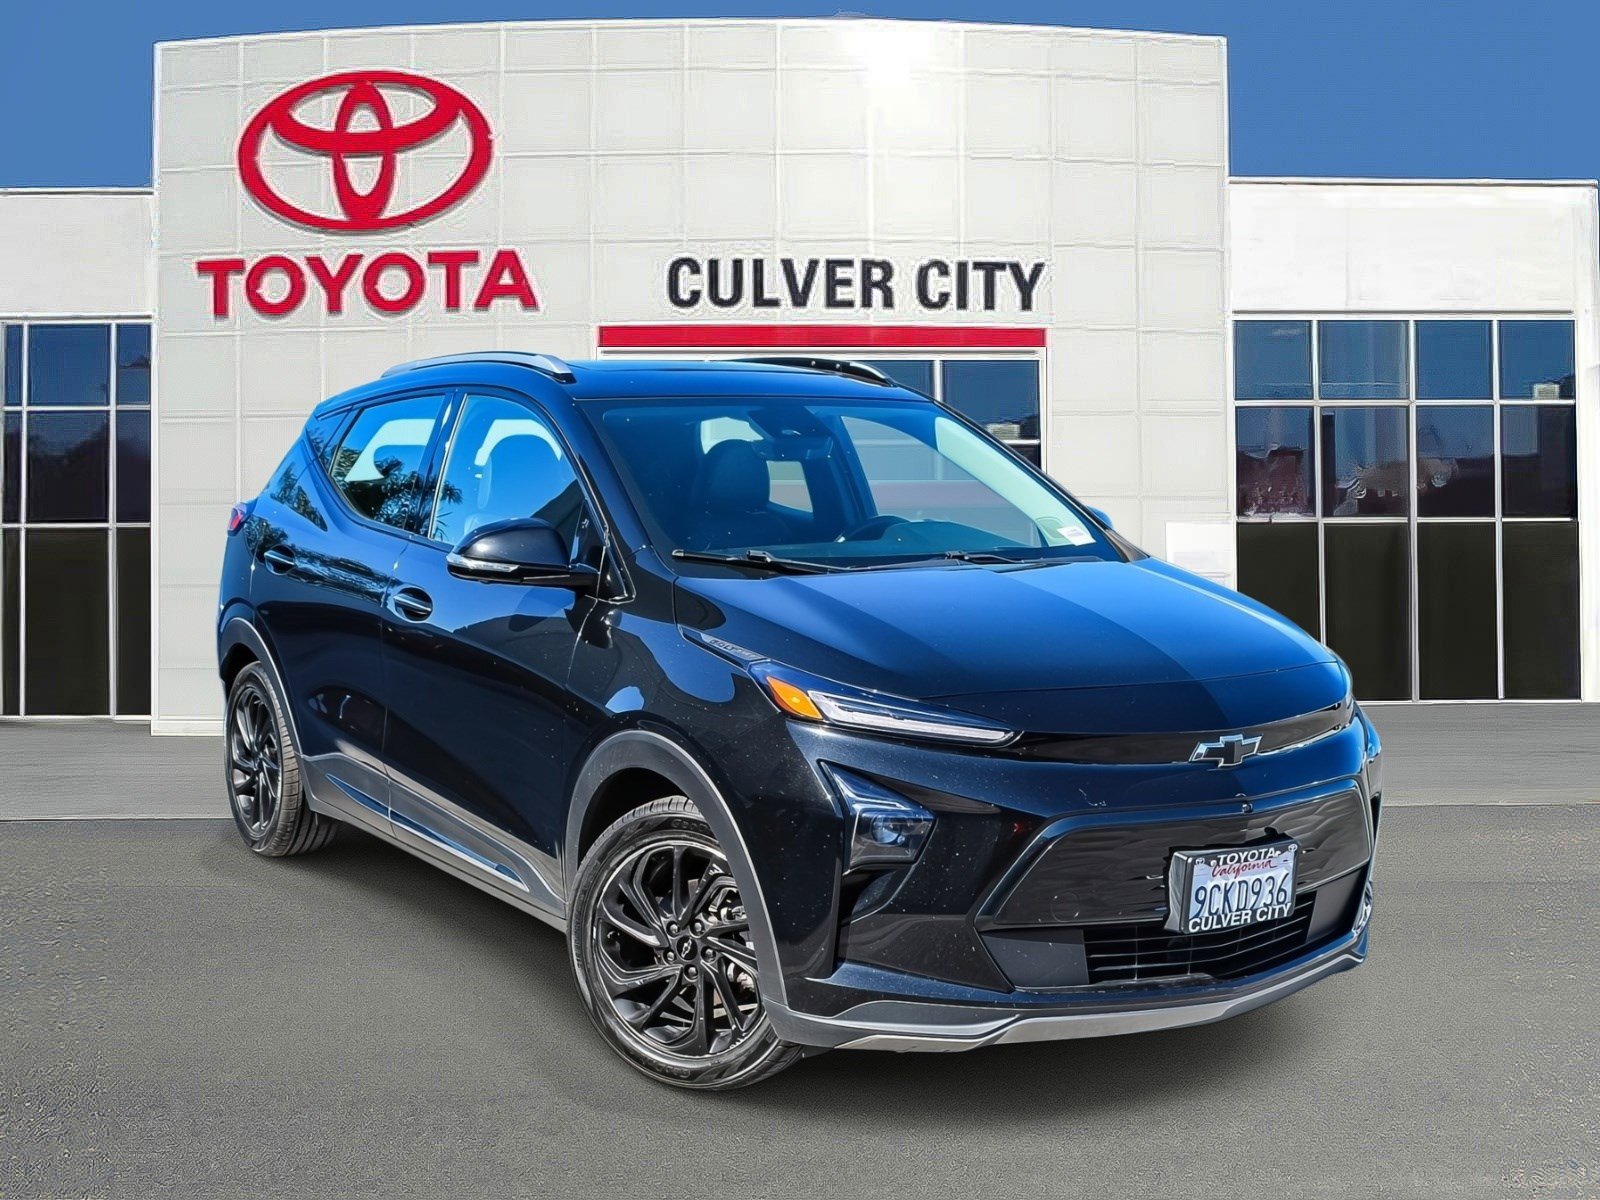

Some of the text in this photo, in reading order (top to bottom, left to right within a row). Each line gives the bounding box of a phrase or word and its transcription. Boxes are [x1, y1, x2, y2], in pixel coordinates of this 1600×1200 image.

[195, 249, 540, 319] TOYOTA
[667, 257, 1046, 311] CULVER CITY
[1211, 859, 1277, 879] California
[1217, 847, 1276, 866] TOYOTA
[1190, 872, 1290, 920] 9CKD936
[1188, 902, 1292, 933] CULVER CITY
